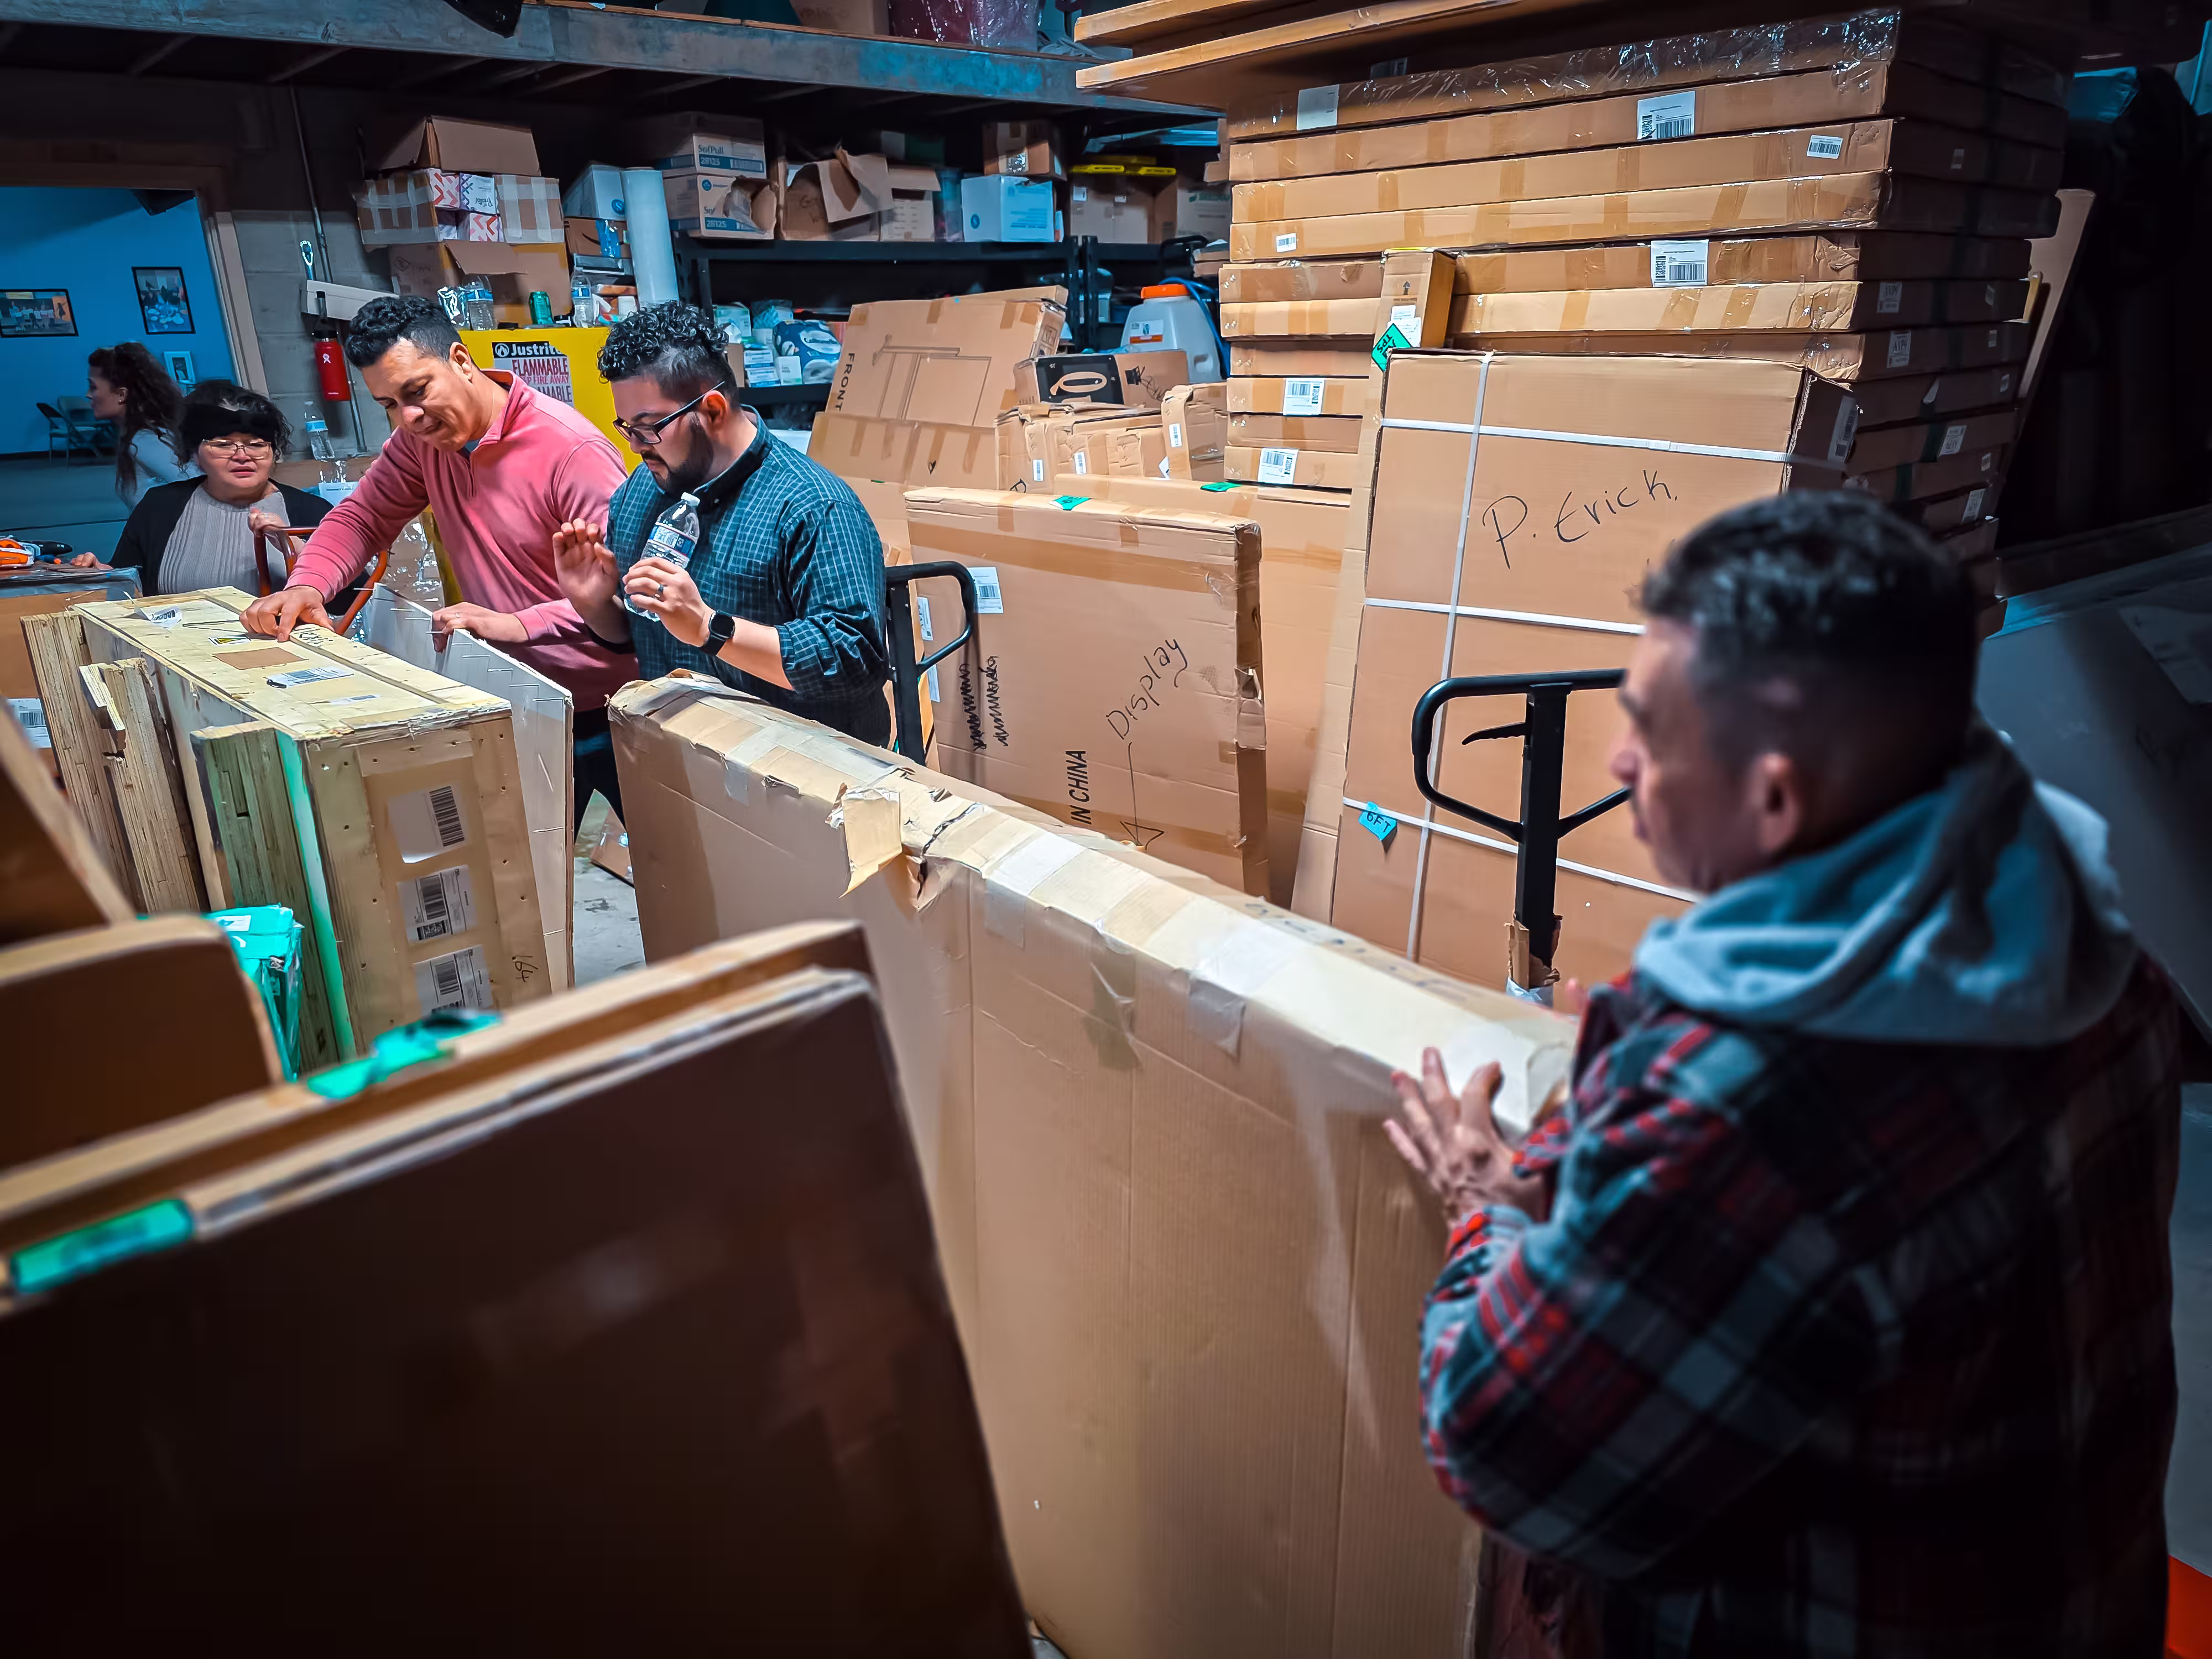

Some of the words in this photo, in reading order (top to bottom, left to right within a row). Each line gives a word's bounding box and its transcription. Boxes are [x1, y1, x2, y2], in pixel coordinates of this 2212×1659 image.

[698, 144, 724, 155] SofPull
[1376, 333, 1393, 353] TPS
[512, 358, 569, 376] FLAMMABLE
[534, 375, 549, 384] FIRE
[550, 375, 569, 384] AWAY
[834, 353, 855, 412] FRONT
[1482, 495, 1537, 569] P.
[1065, 749, 1091, 803] CHINA
[1070, 804, 1092, 825] IN
[1365, 811, 1392, 833] 6FT
